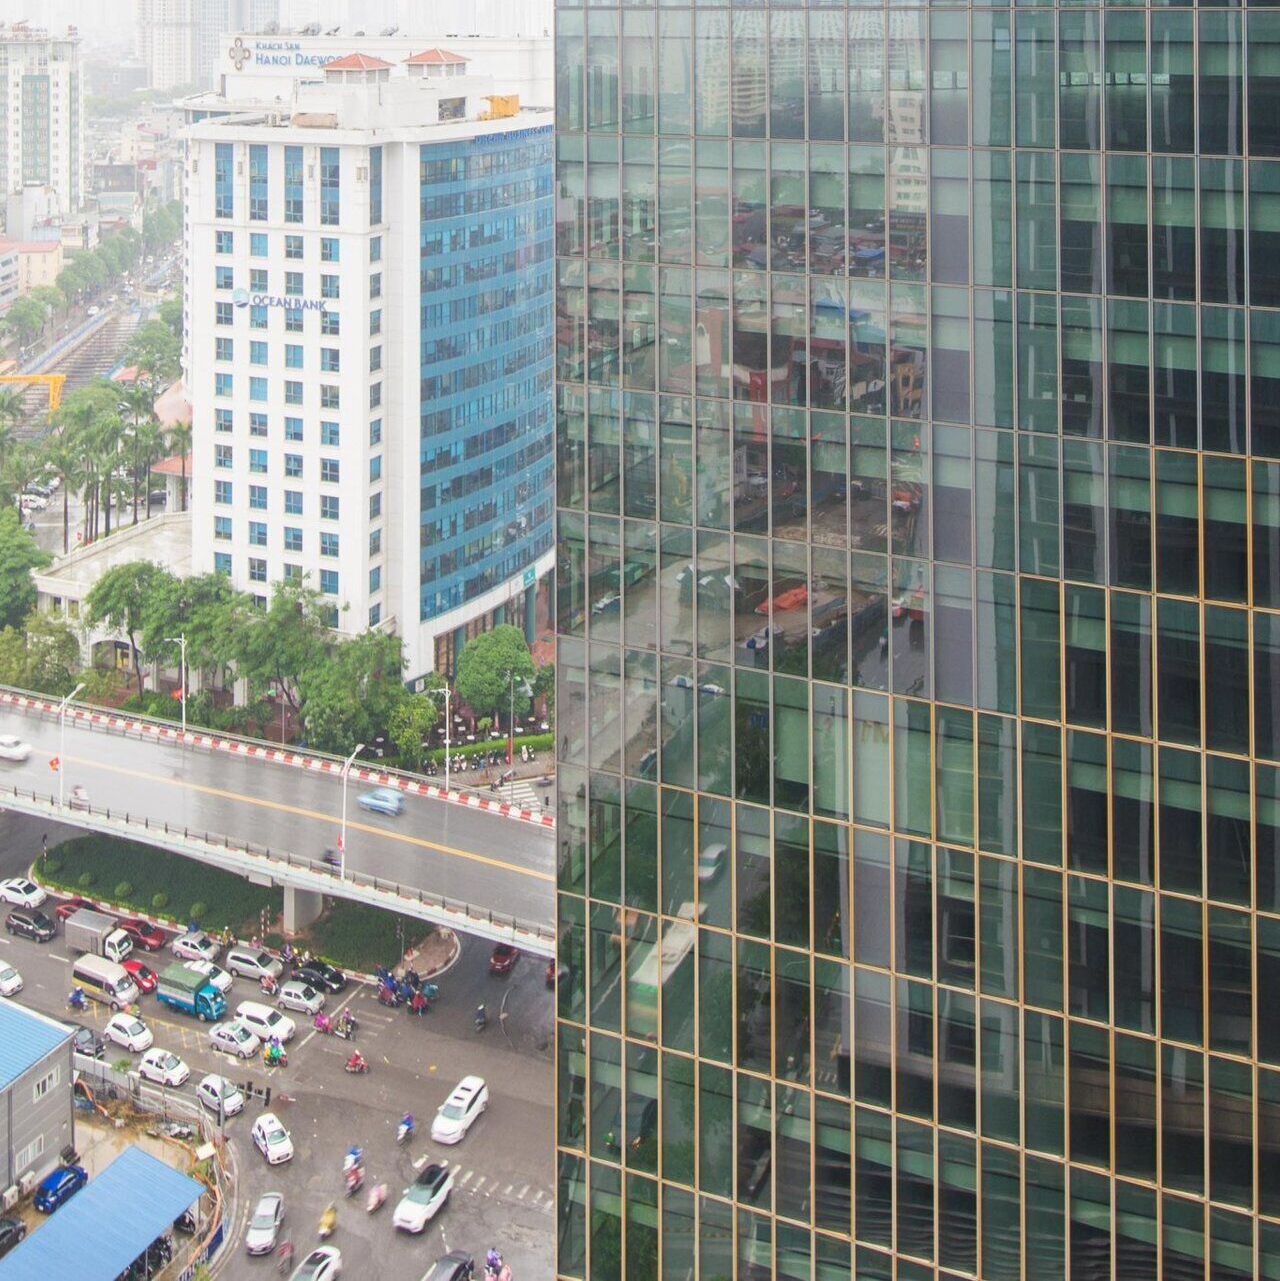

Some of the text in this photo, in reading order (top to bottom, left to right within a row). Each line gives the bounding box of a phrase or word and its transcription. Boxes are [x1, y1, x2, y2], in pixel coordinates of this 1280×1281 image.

[255, 53, 291, 66] HANOI
[252, 294, 327, 313] OCEAN BANK
